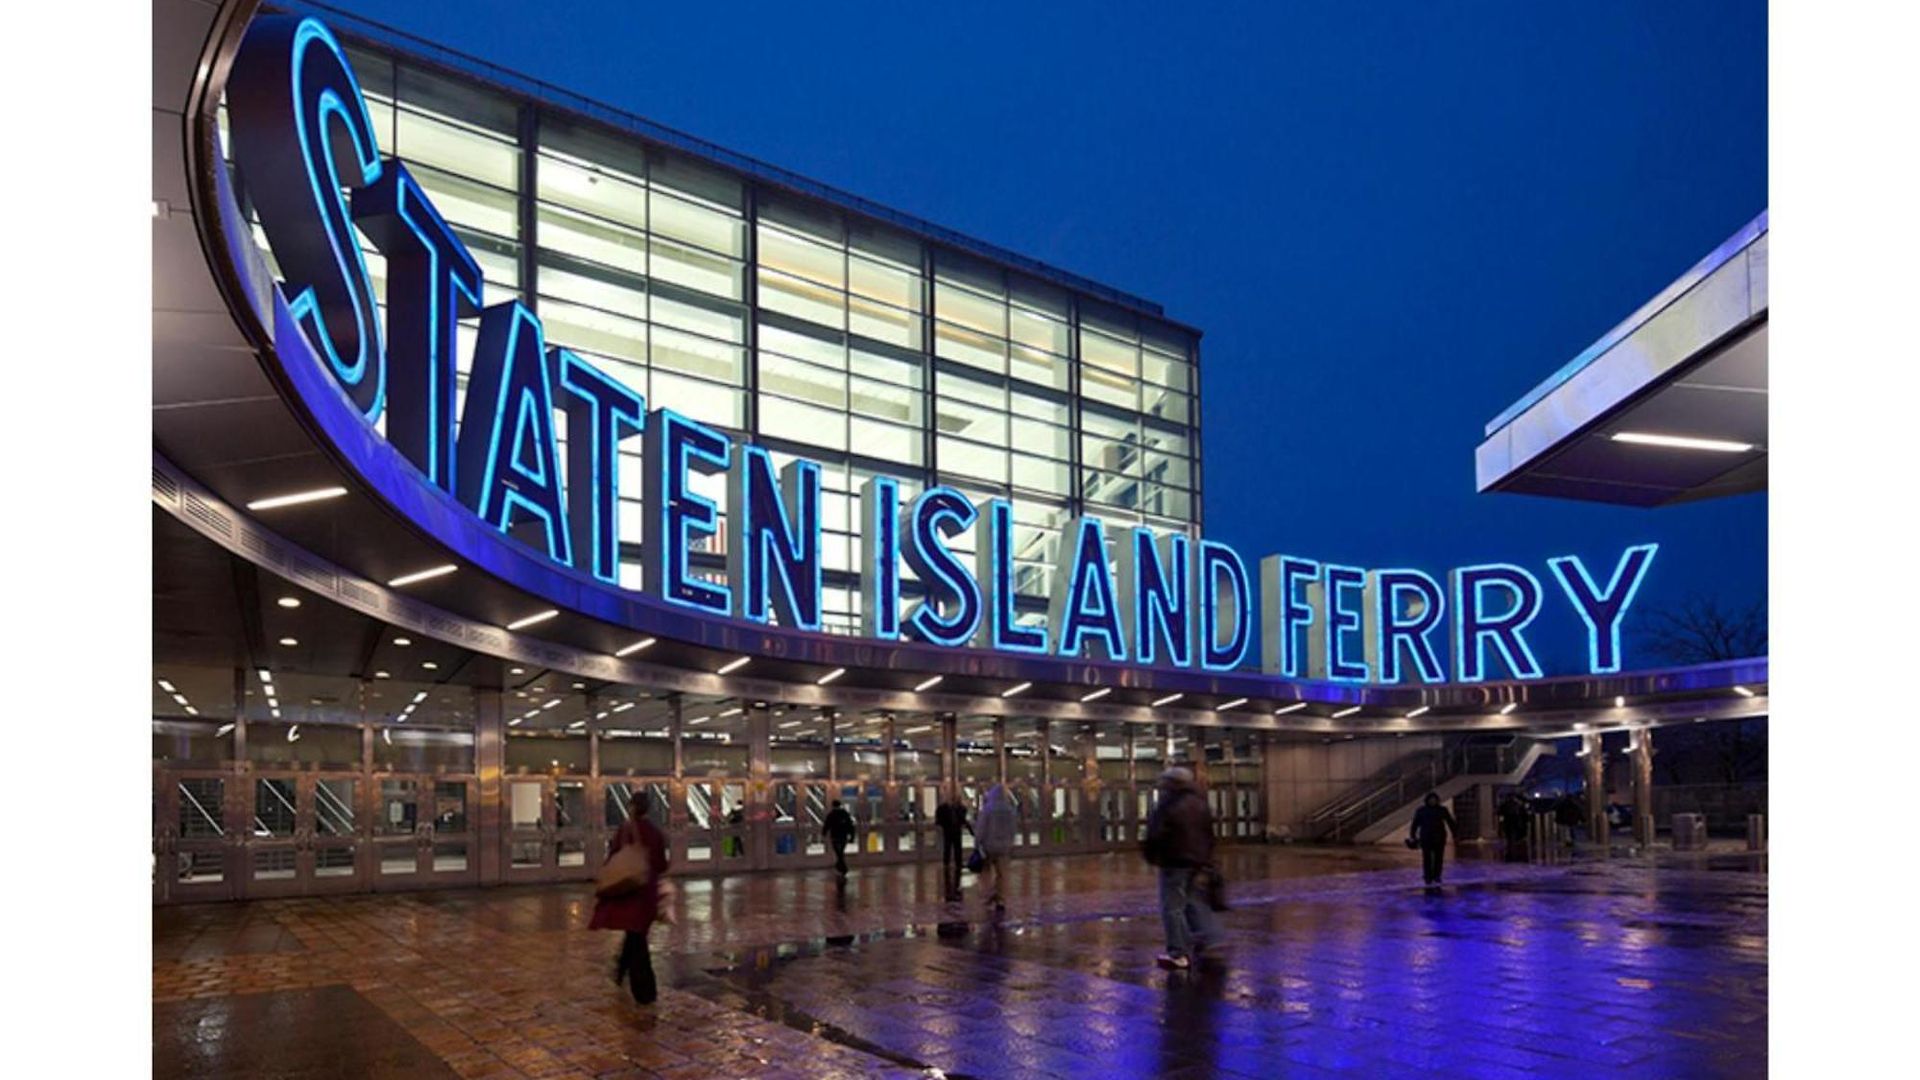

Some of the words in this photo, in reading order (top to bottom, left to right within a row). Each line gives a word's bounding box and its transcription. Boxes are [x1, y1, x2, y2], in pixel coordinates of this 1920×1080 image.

[286, 16, 822, 631] STATEN
[872, 475, 1253, 672] ISLAND
[1279, 542, 1659, 683] FERRY
